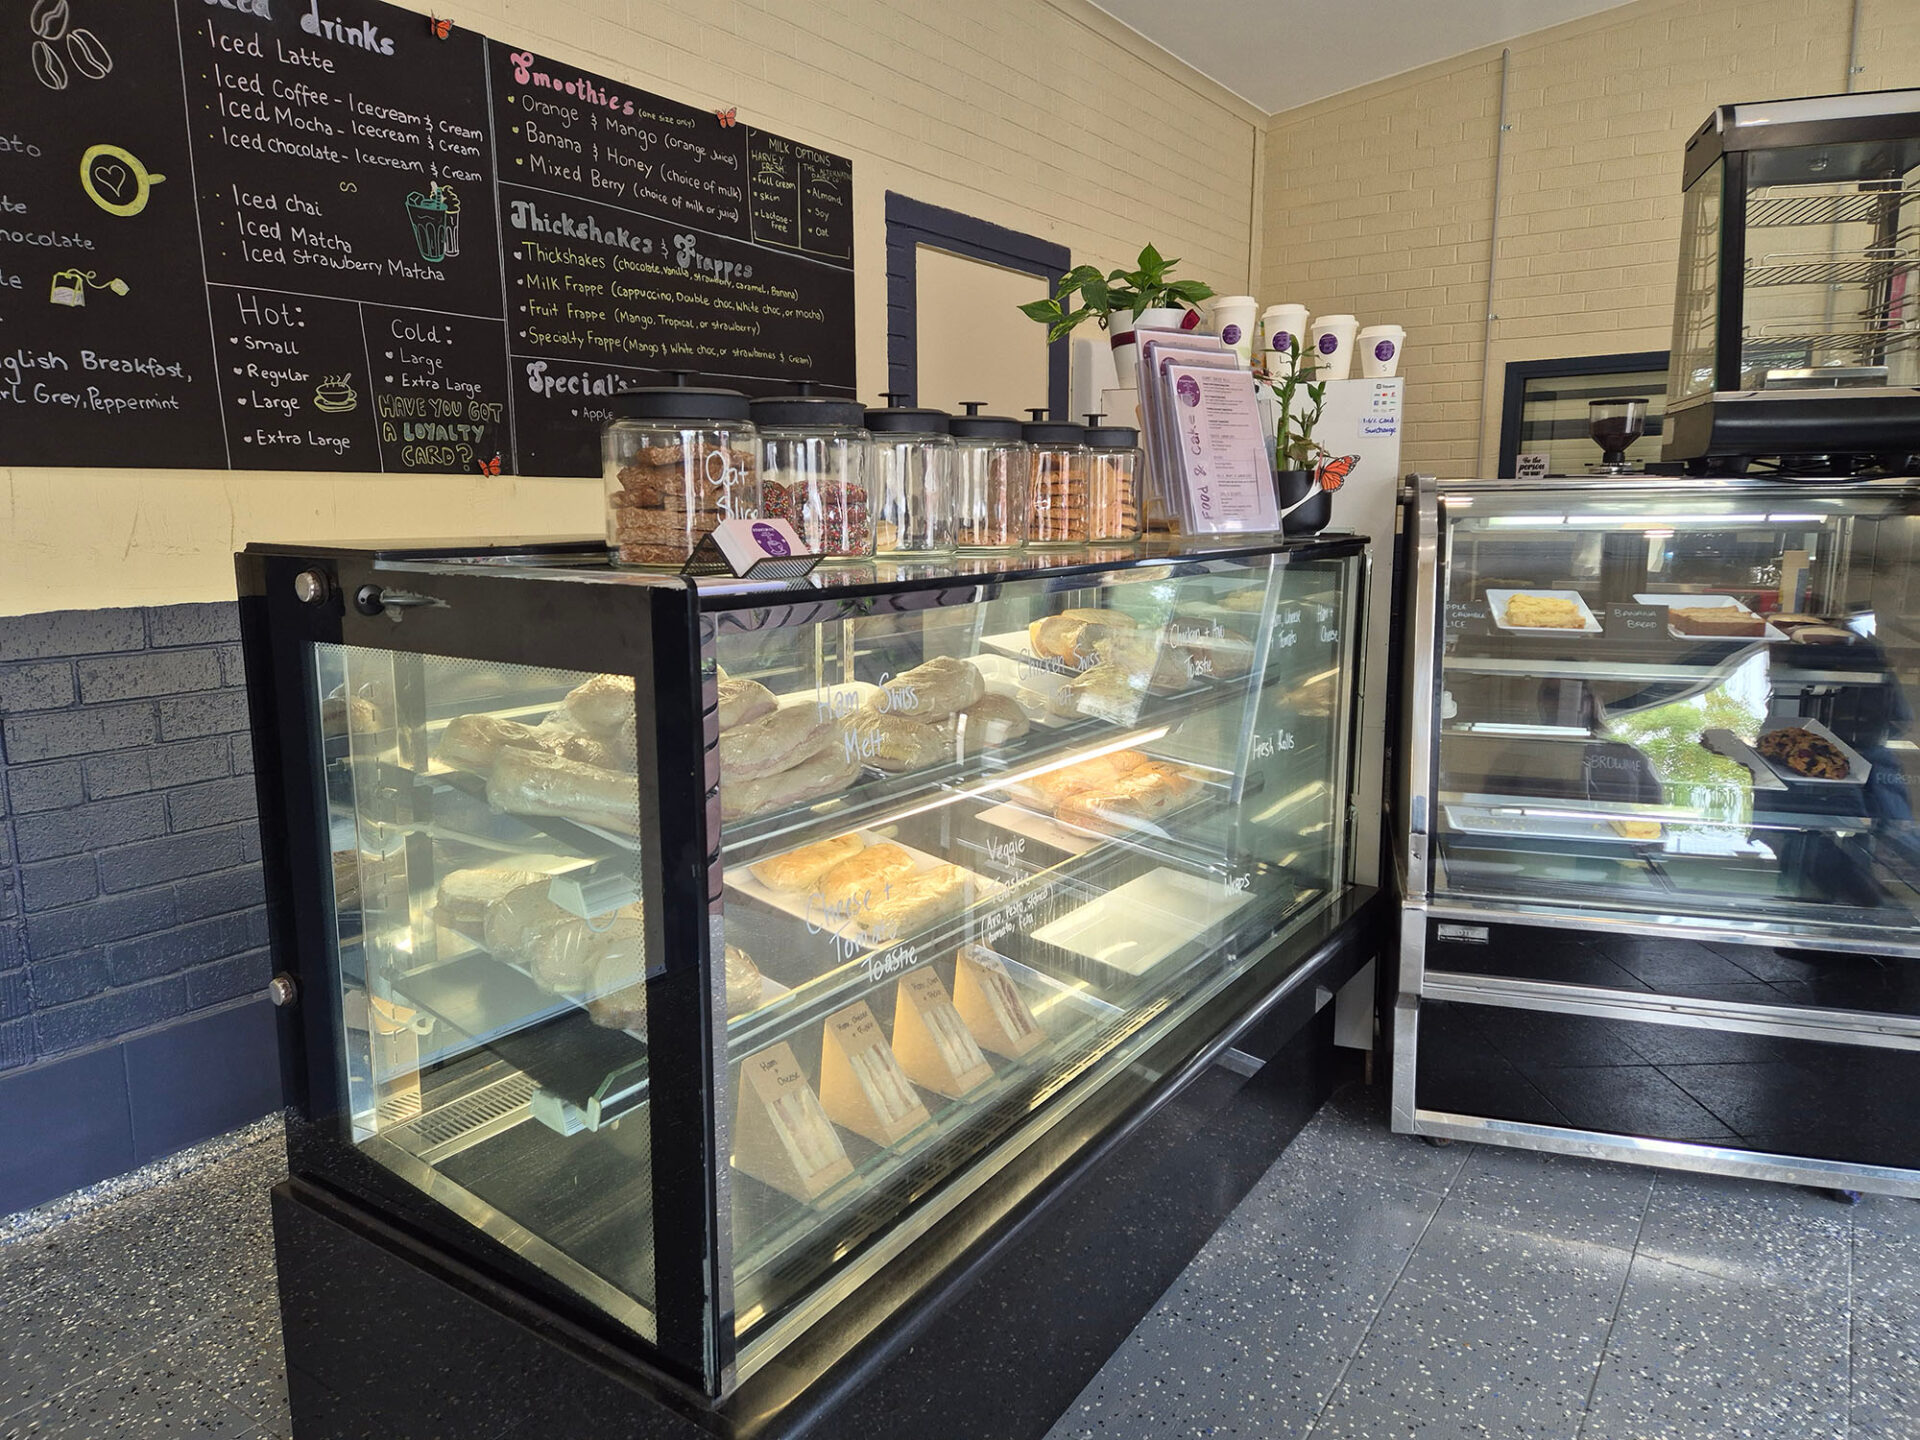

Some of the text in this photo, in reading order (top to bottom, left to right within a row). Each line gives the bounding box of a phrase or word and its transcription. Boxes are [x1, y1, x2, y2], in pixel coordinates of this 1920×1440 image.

[207, 18, 335, 74] Iced Latte
[510, 51, 635, 116] Smoothies
[214, 63, 264, 97] Iced
[272, 79, 328, 106] Coffee
[349, 93, 421, 126] Icecream
[439, 119, 484, 142] Cream
[219, 92, 270, 122] Iced
[275, 106, 333, 137] Mocha
[352, 120, 420, 146] Icecream
[439, 140, 481, 157] Cream
[522, 94, 580, 129] Orange
[606, 117, 658, 152] Mango
[222, 126, 265, 153] Iced
[355, 149, 424, 174] Icecream
[442, 166, 482, 182] Cream
[526, 121, 582, 154] Banana
[607, 147, 653, 180] Honey
[660, 163, 700, 190] (choice
[703, 180, 717, 194] of
[718, 186, 743, 203] milk)
[751, 150, 785, 166] HARVEY
[761, 162, 786, 173] FRESH
[768, 138, 832, 167] MILK OPTIONS
[530, 153, 582, 183] Mixed
[591, 169, 626, 198] Berry
[633, 182, 668, 205] (choice
[671, 196, 683, 209] of
[685, 199, 704, 214] milk
[757, 174, 774, 187] Full
[233, 184, 323, 217] Iced chai
[812, 187, 844, 207] Almond
[814, 207, 831, 222] Soy
[238, 211, 352, 254] Iced Matcha
[511, 200, 653, 254] Thickshakes
[673, 233, 753, 282] Frappes
[815, 227, 831, 238] Oat
[242, 240, 445, 281] Iced Strawberry Matcha
[521, 241, 607, 269] Thickshakes
[526, 273, 561, 292] Milk
[564, 275, 604, 298] Frappe
[676, 292, 711, 307] Double
[785, 309, 794, 317] or
[237, 293, 305, 328] Hot:
[528, 299, 559, 317] Fruit
[567, 302, 607, 322] Frappe
[699, 320, 709, 329] or
[244, 336, 300, 355] Small
[528, 325, 585, 349] Specialty
[586, 330, 622, 352] Frappe
[622, 336, 659, 358] (Mango
[719, 347, 728, 356] or
[0, 349, 192, 386] glish Breakfast,
[247, 364, 310, 388] Regular
[401, 347, 444, 375] Large
[402, 376, 482, 400] Extra Large
[252, 390, 300, 417] Large
[378, 394, 503, 424] HAVE YOU GOT
[583, 406, 615, 423] Apple
[256, 429, 351, 455] Extra Large
[382, 422, 485, 443] A LOYALTY
[401, 443, 474, 472] CARD?
[705, 450, 749, 486] Oat
[816, 681, 860, 724] Ham
[1252, 734, 1275, 761] Fresh
[986, 834, 1027, 870] Veggie
